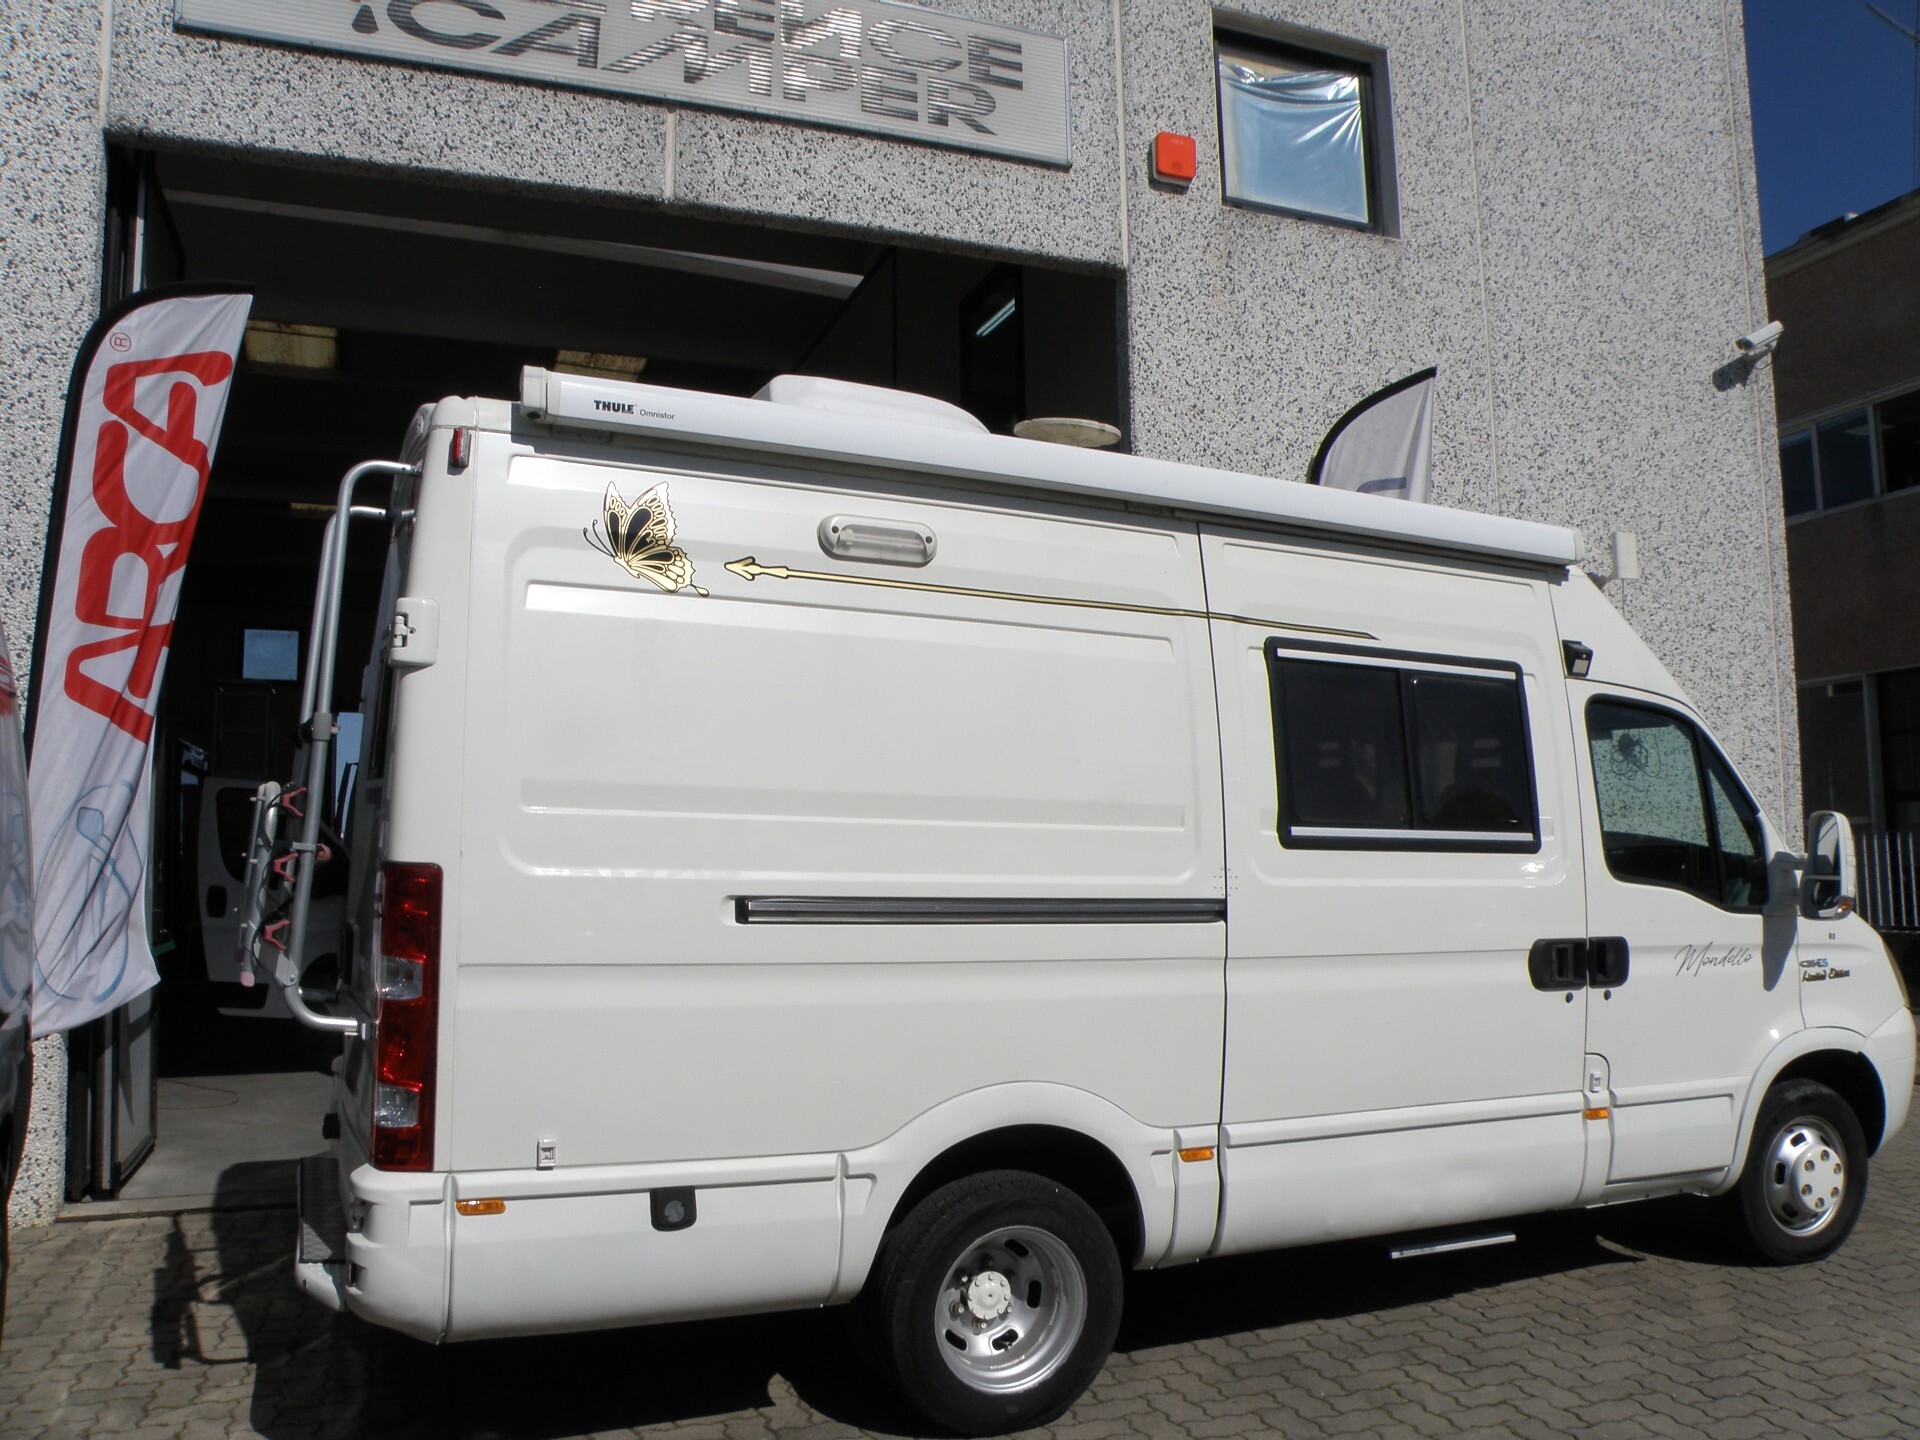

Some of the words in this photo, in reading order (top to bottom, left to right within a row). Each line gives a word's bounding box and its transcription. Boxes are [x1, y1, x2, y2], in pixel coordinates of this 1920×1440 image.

[594, 400, 635, 415] THULE
[640, 409, 676, 421] Omnistor
[64, 350, 234, 745] ARCA
